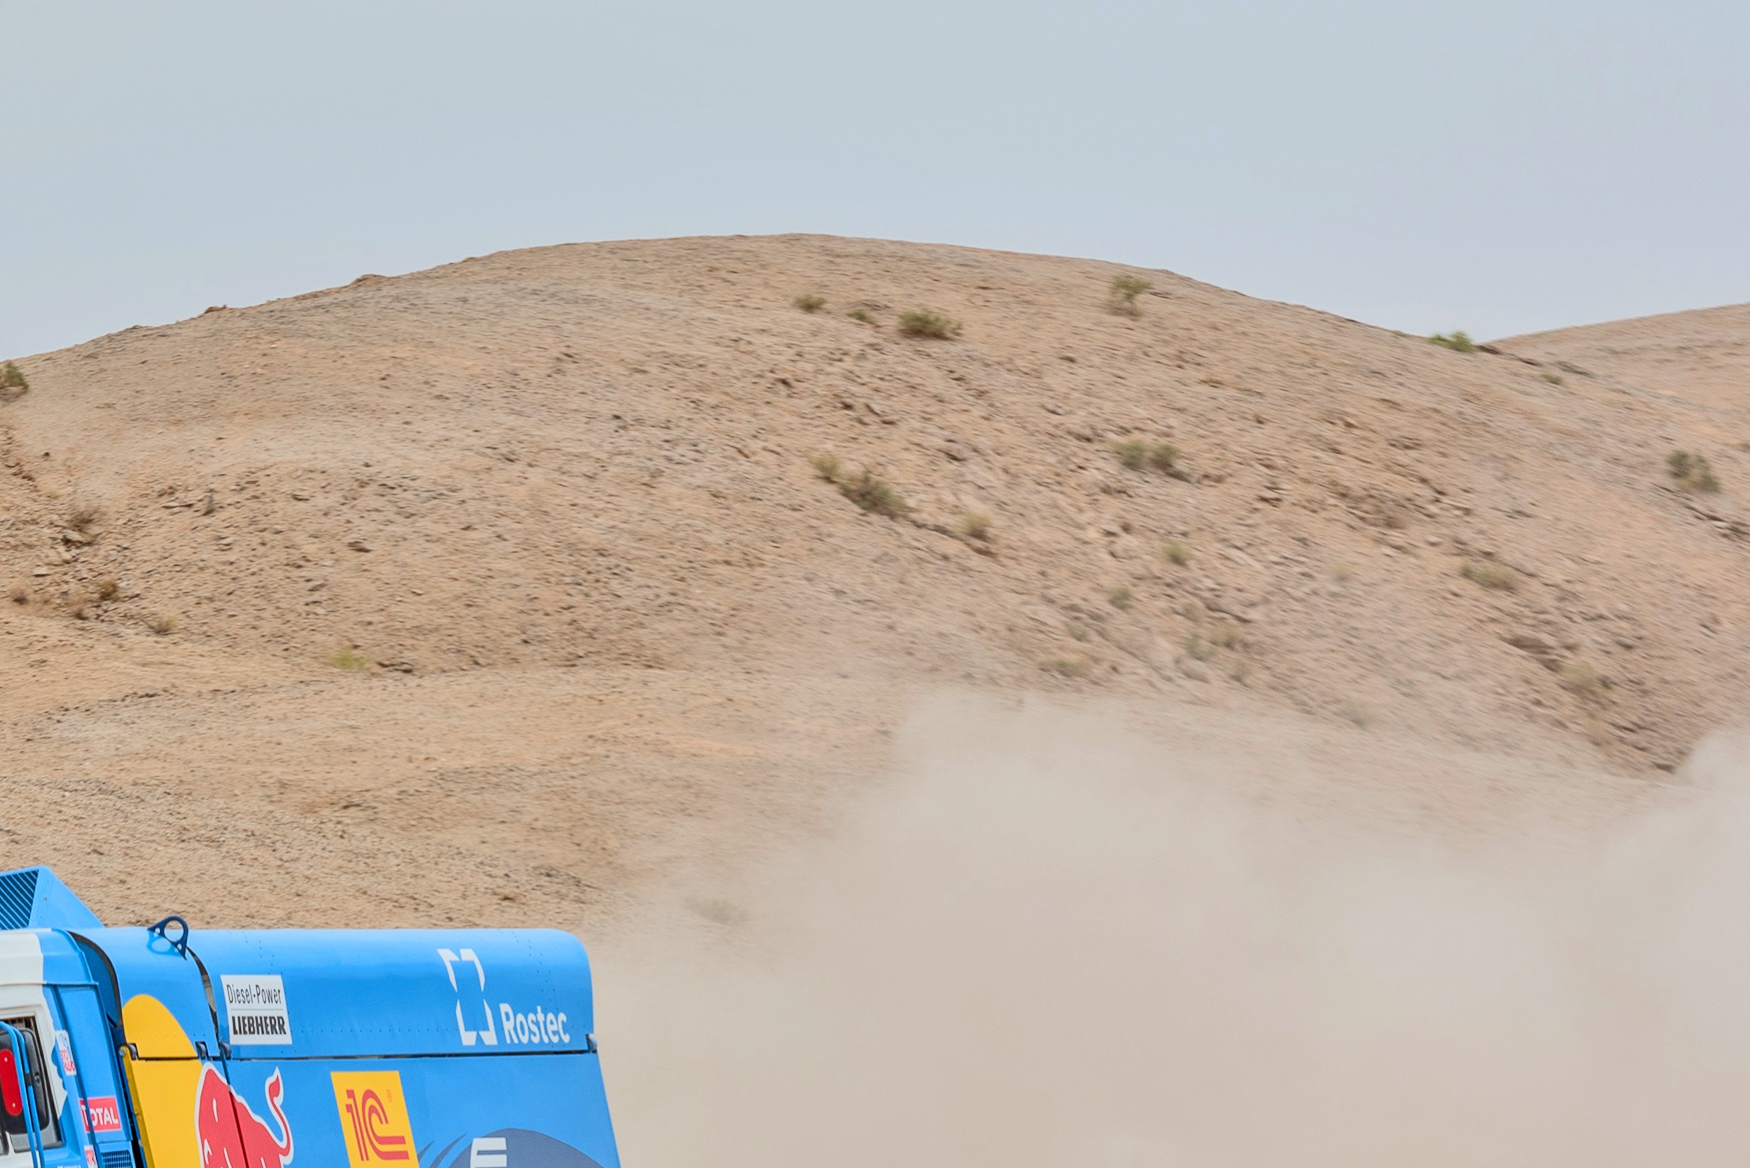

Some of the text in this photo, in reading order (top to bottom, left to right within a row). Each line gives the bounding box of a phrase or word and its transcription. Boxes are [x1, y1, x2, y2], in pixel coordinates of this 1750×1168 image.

[226, 984, 282, 1005] Diesel-Power
[231, 1015, 287, 1036] LIEBHERR
[500, 1003, 571, 1045] Rostec
[81, 1104, 118, 1127] TOTAL
